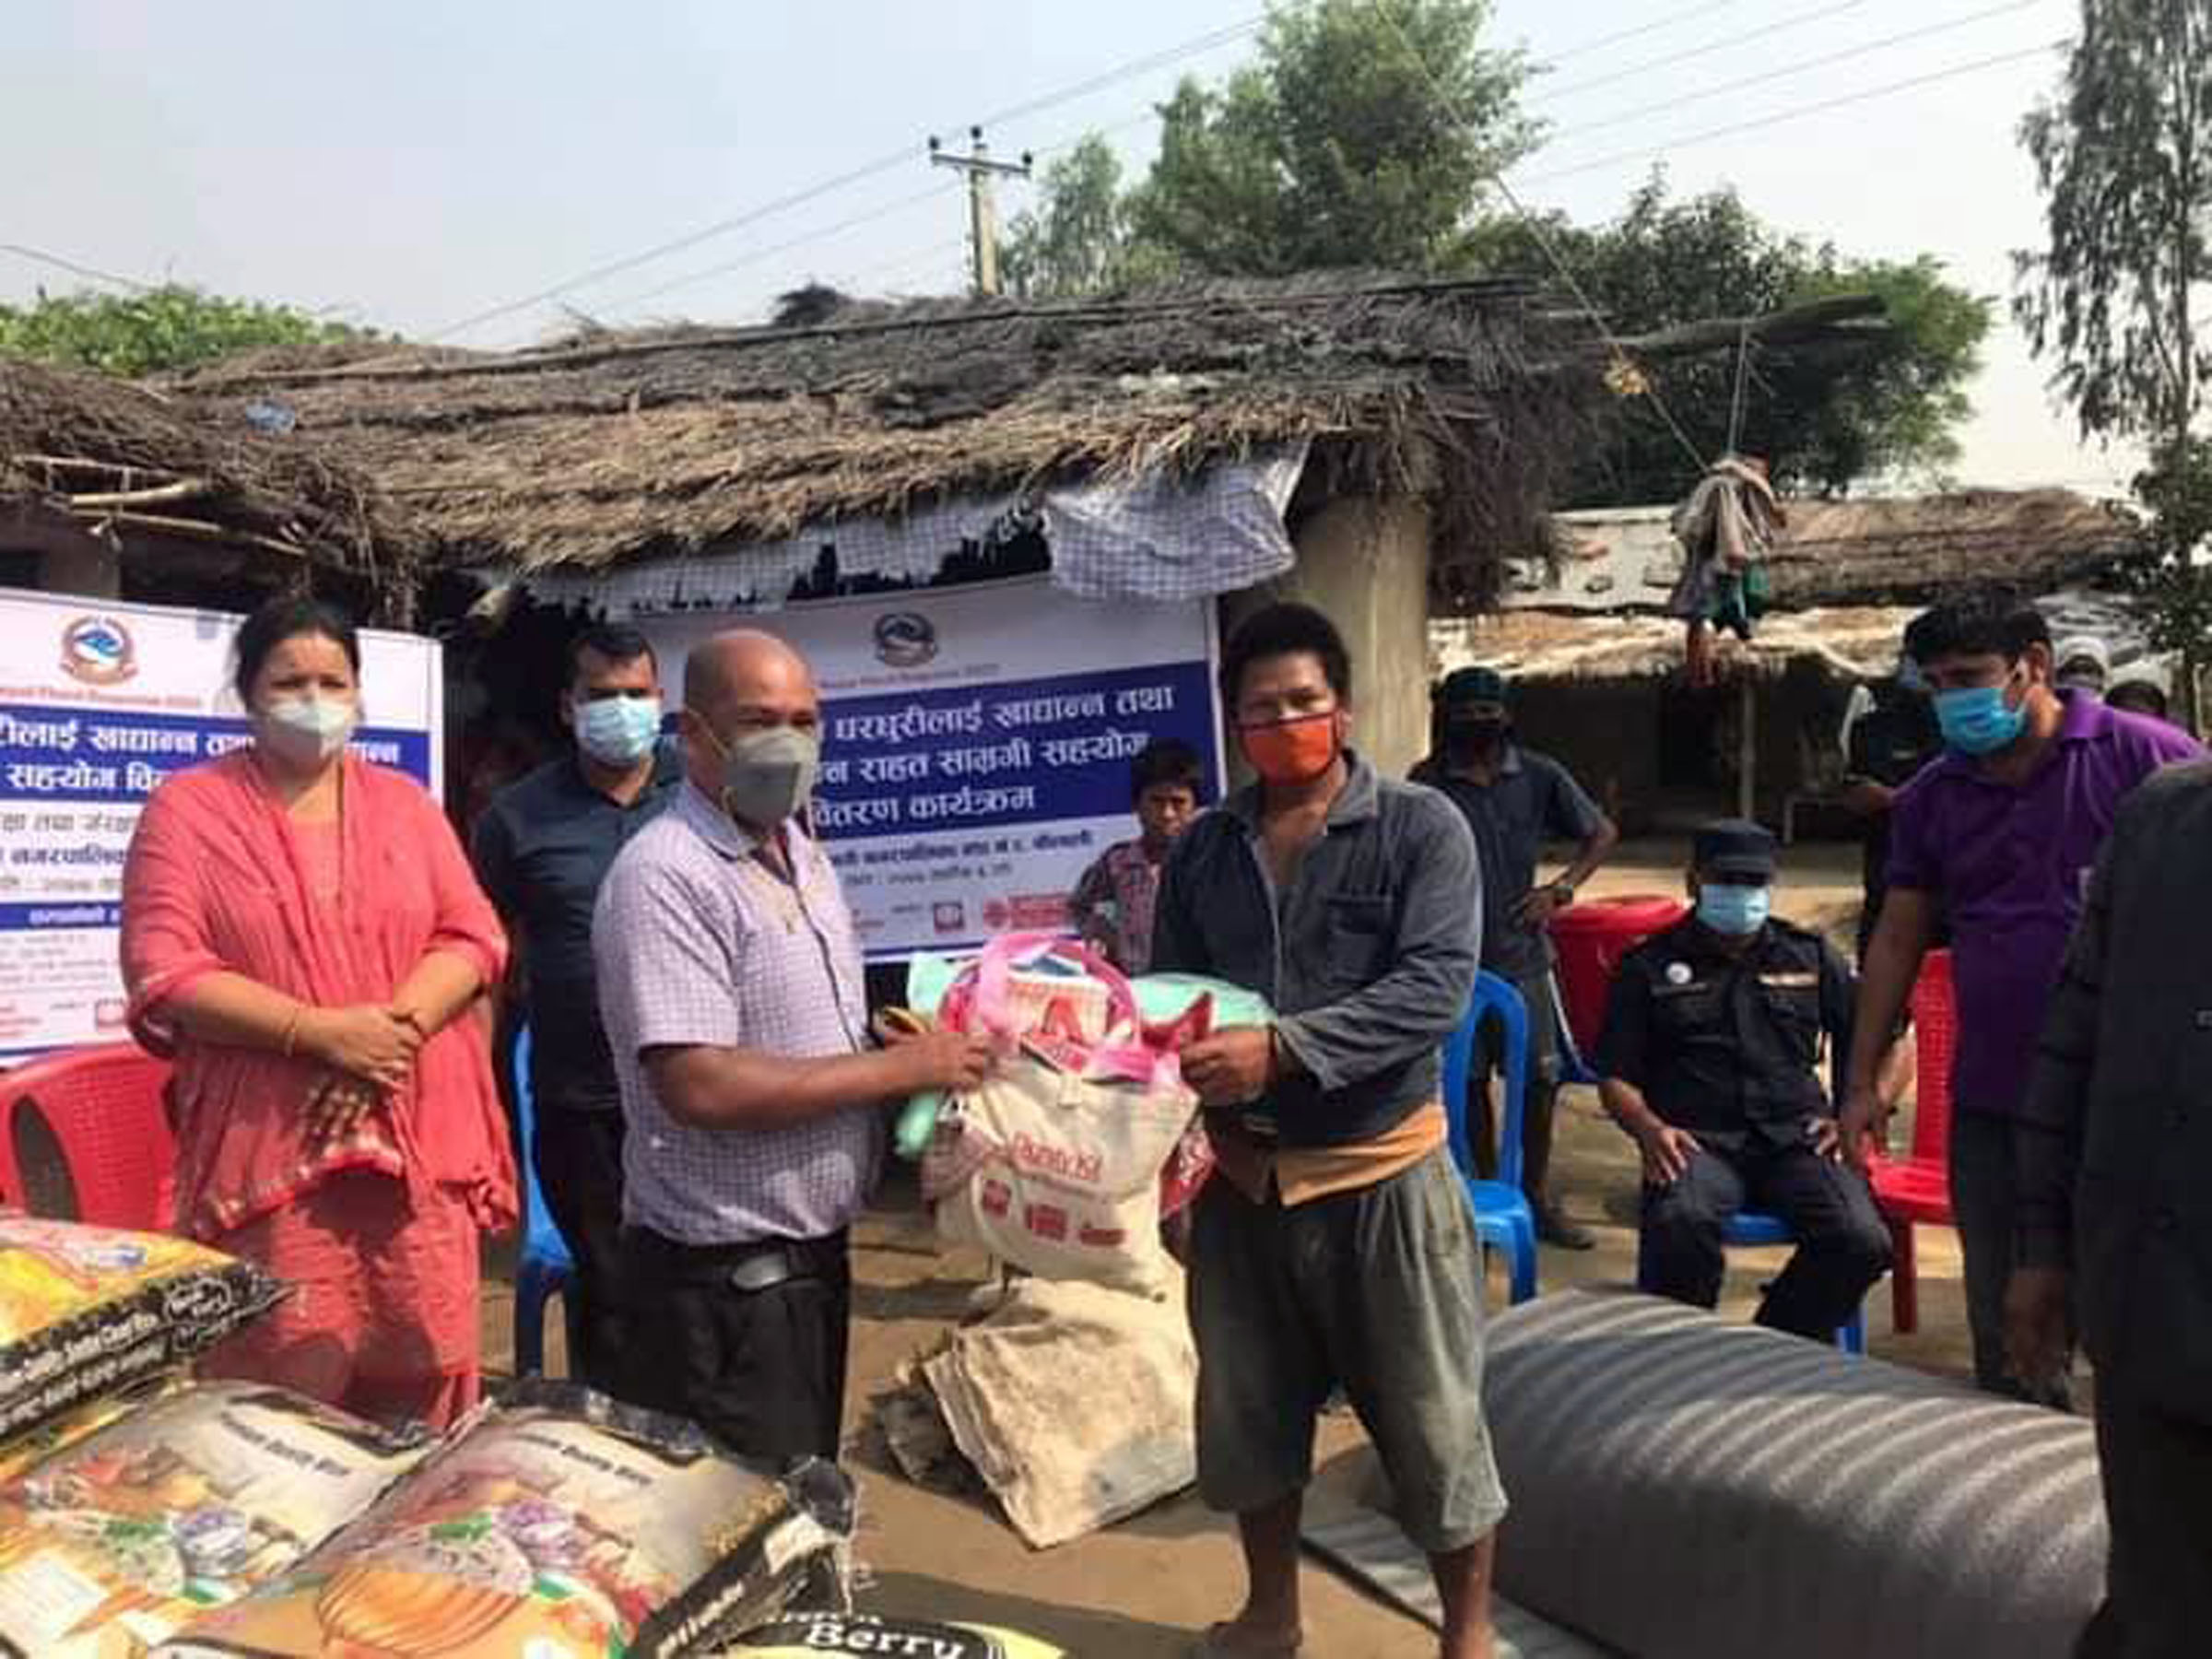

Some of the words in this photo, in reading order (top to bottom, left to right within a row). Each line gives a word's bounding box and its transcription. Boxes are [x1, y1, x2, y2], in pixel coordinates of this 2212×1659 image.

[990, 693, 1106, 727] खाद्यान्न
[1116, 686, 1174, 715] तथा
[858, 752, 929, 782] राहत
[1039, 726, 1150, 767] सहयोग
[6, 759, 118, 791] सहयोग
[909, 783, 1036, 819] कार्यक्रम
[805, 1619, 966, 1659] Berry
